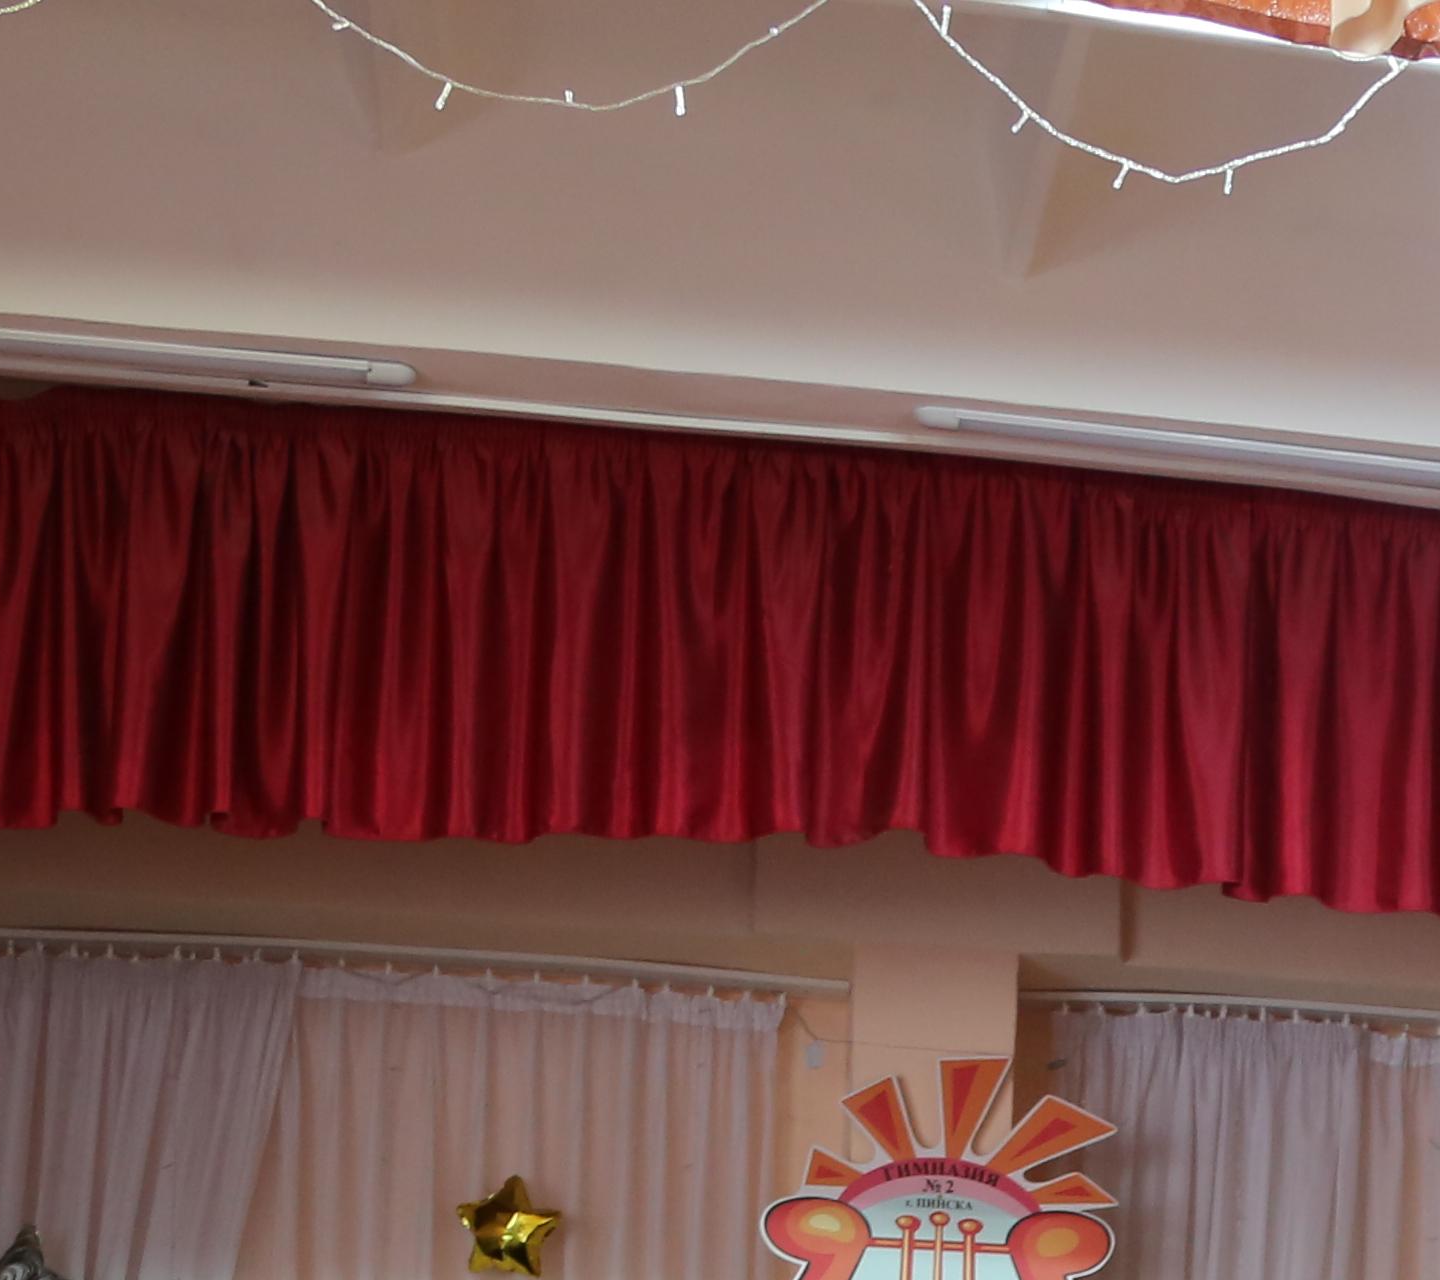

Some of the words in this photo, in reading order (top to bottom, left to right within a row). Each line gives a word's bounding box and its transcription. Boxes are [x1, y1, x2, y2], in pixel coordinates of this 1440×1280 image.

[883, 1160, 999, 1187] ГИМНАЗИЯ
[946, 1180, 954, 1193] 2
[916, 1198, 973, 1210] ПИНСКА
